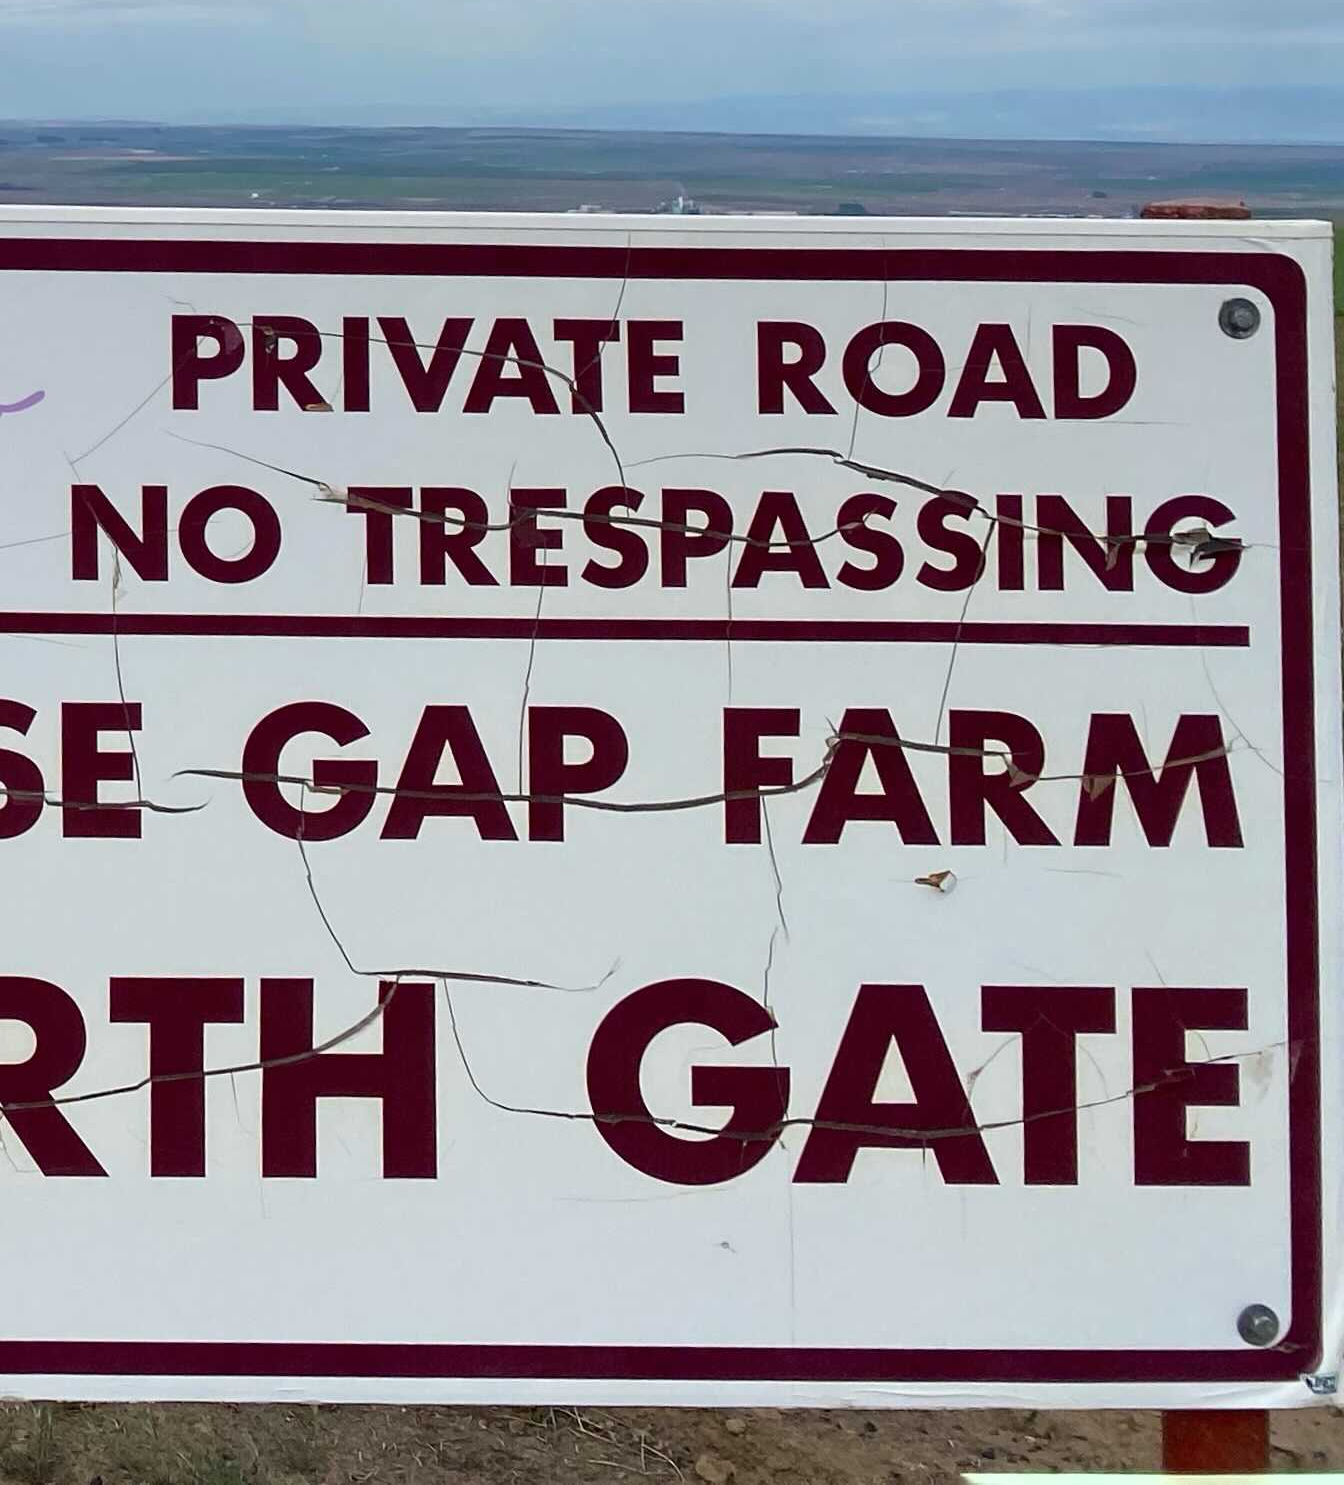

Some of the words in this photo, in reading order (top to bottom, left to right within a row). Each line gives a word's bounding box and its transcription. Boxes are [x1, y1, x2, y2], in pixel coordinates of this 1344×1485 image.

[172, 314, 684, 415] PRIVATE
[757, 320, 1137, 420] ROAD
[70, 484, 282, 585] NO
[345, 484, 1244, 594] TRESPASSING
[242, 701, 629, 843] GAP
[723, 706, 1245, 848] FARM
[586, 977, 1251, 1187] GATE
